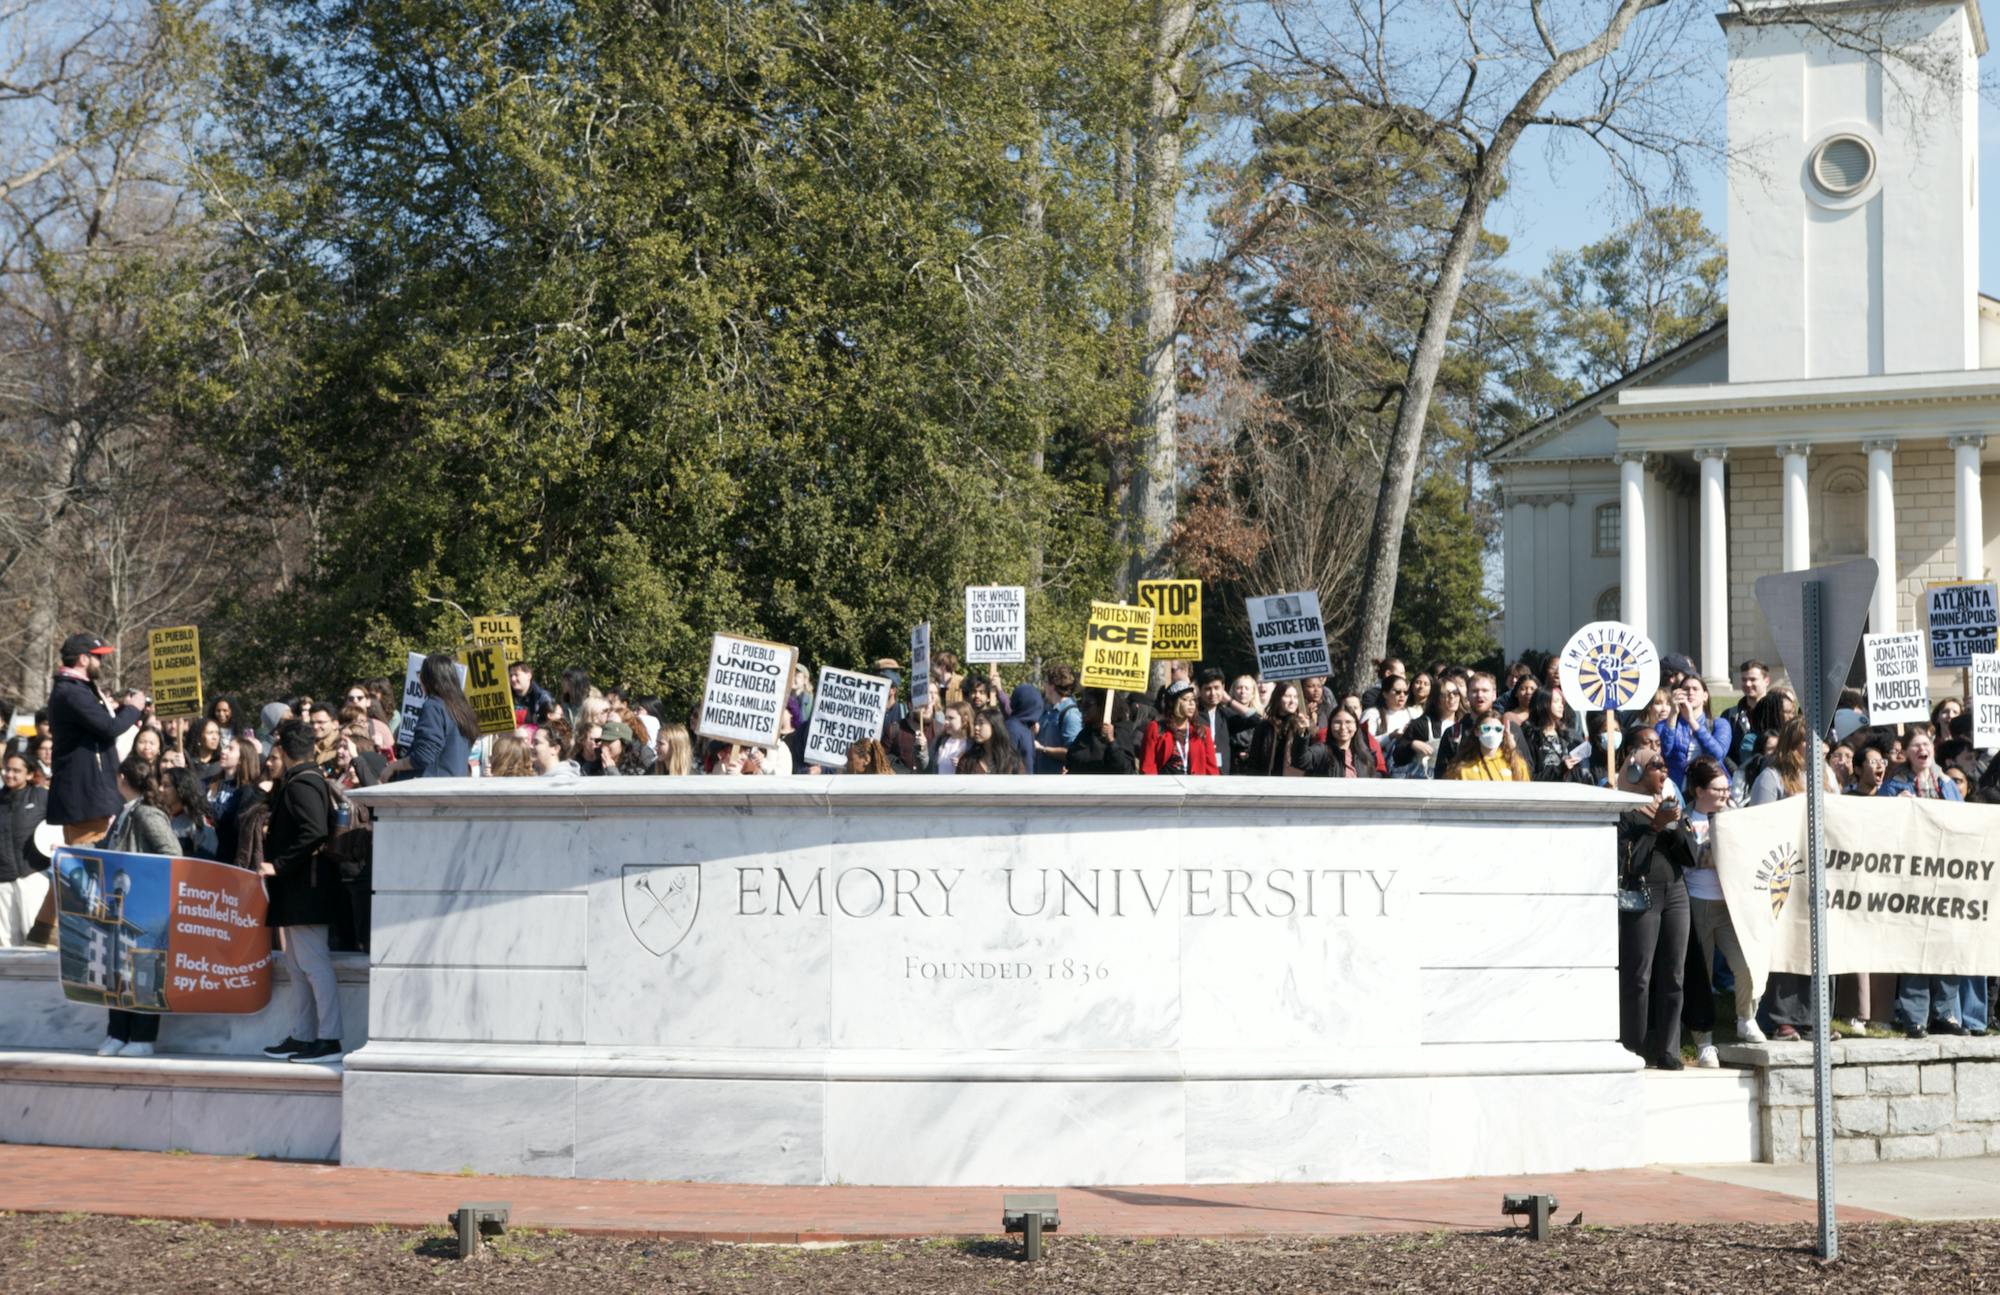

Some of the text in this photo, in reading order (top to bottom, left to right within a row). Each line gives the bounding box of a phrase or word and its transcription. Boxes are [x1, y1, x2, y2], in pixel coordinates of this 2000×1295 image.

[972, 590, 1019, 602] THE WHOLE
[1141, 584, 1198, 616] STOP
[1934, 590, 1991, 610] ATLANTA
[973, 609, 1018, 623] IS GUILTY
[1091, 606, 1151, 624] PROTESTING
[1930, 609, 1997, 627] MINNEAPOLIS
[165, 630, 194, 642] PUEBLO
[481, 621, 513, 633] FULL
[1089, 623, 1148, 645] ICE
[1160, 623, 1198, 638] TERROR
[1255, 616, 1320, 638] JUSTICE FOR
[1931, 625, 1997, 640] STOP
[975, 634, 1016, 651] DOWN!
[1258, 638, 1324, 654] RENEE
[1869, 634, 1920, 646] ARREST
[743, 645, 775, 661] PUEBLO
[1095, 649, 1105, 664] IS
[1108, 650, 1130, 666] NOT
[1132, 652, 1139, 667] A
[1873, 644, 1919, 662] JONATHAN
[1933, 642, 1952, 657] ICE
[154, 655, 196, 670] LA AGENDA
[717, 655, 781, 676] UNIDO
[1260, 649, 1326, 669] NICOLE GOOD
[467, 648, 499, 689] ICE
[1085, 666, 1146, 678] CRIME!
[1877, 661, 1900, 677] ROSS
[1901, 660, 1918, 674] FOR
[824, 672, 884, 692] FIGHT
[1875, 679, 1921, 700] MURDER
[156, 690, 166, 701] DE
[470, 692, 506, 709] OUT OF OUR
[709, 690, 777, 713] A LAS FAMILIAS
[821, 683, 856, 704] RACISM,
[819, 699, 836, 715] AND
[1872, 699, 1926, 712] NOW!
[705, 706, 774, 734] MIGRANTES!
[838, 723, 846, 739] 3
[846, 725, 875, 741] EVILS
[810, 734, 825, 750] OF
[1824, 848, 1995, 881] UPPORT EMORY
[179, 881, 239, 907] Emory has
[733, 866, 1399, 918] EMORY UNIVERSITY
[178, 900, 259, 928] installed Flock
[1867, 891, 1989, 921] WORKERS!
[177, 921, 231, 941] cameras.
[176, 952, 210, 972] Flock
[904, 955, 1110, 986] FOUNDED 1836
[173, 974, 257, 991] spy for ICE.
